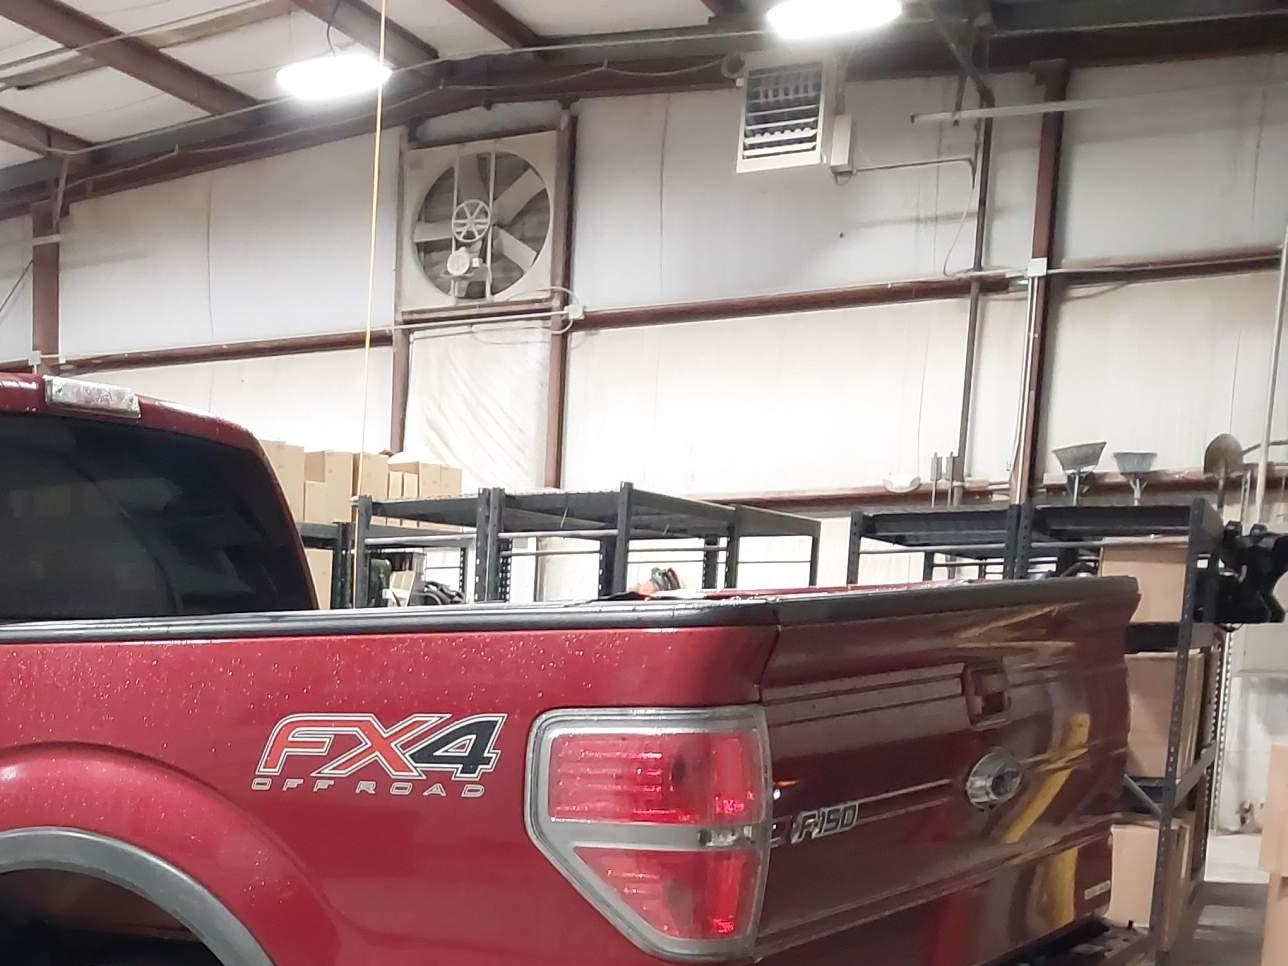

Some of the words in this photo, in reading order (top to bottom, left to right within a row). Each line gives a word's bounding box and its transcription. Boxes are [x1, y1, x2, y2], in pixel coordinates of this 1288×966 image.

[255, 713, 508, 781] FX4
[251, 777, 335, 793] OFF
[354, 780, 486, 798] ROAD
